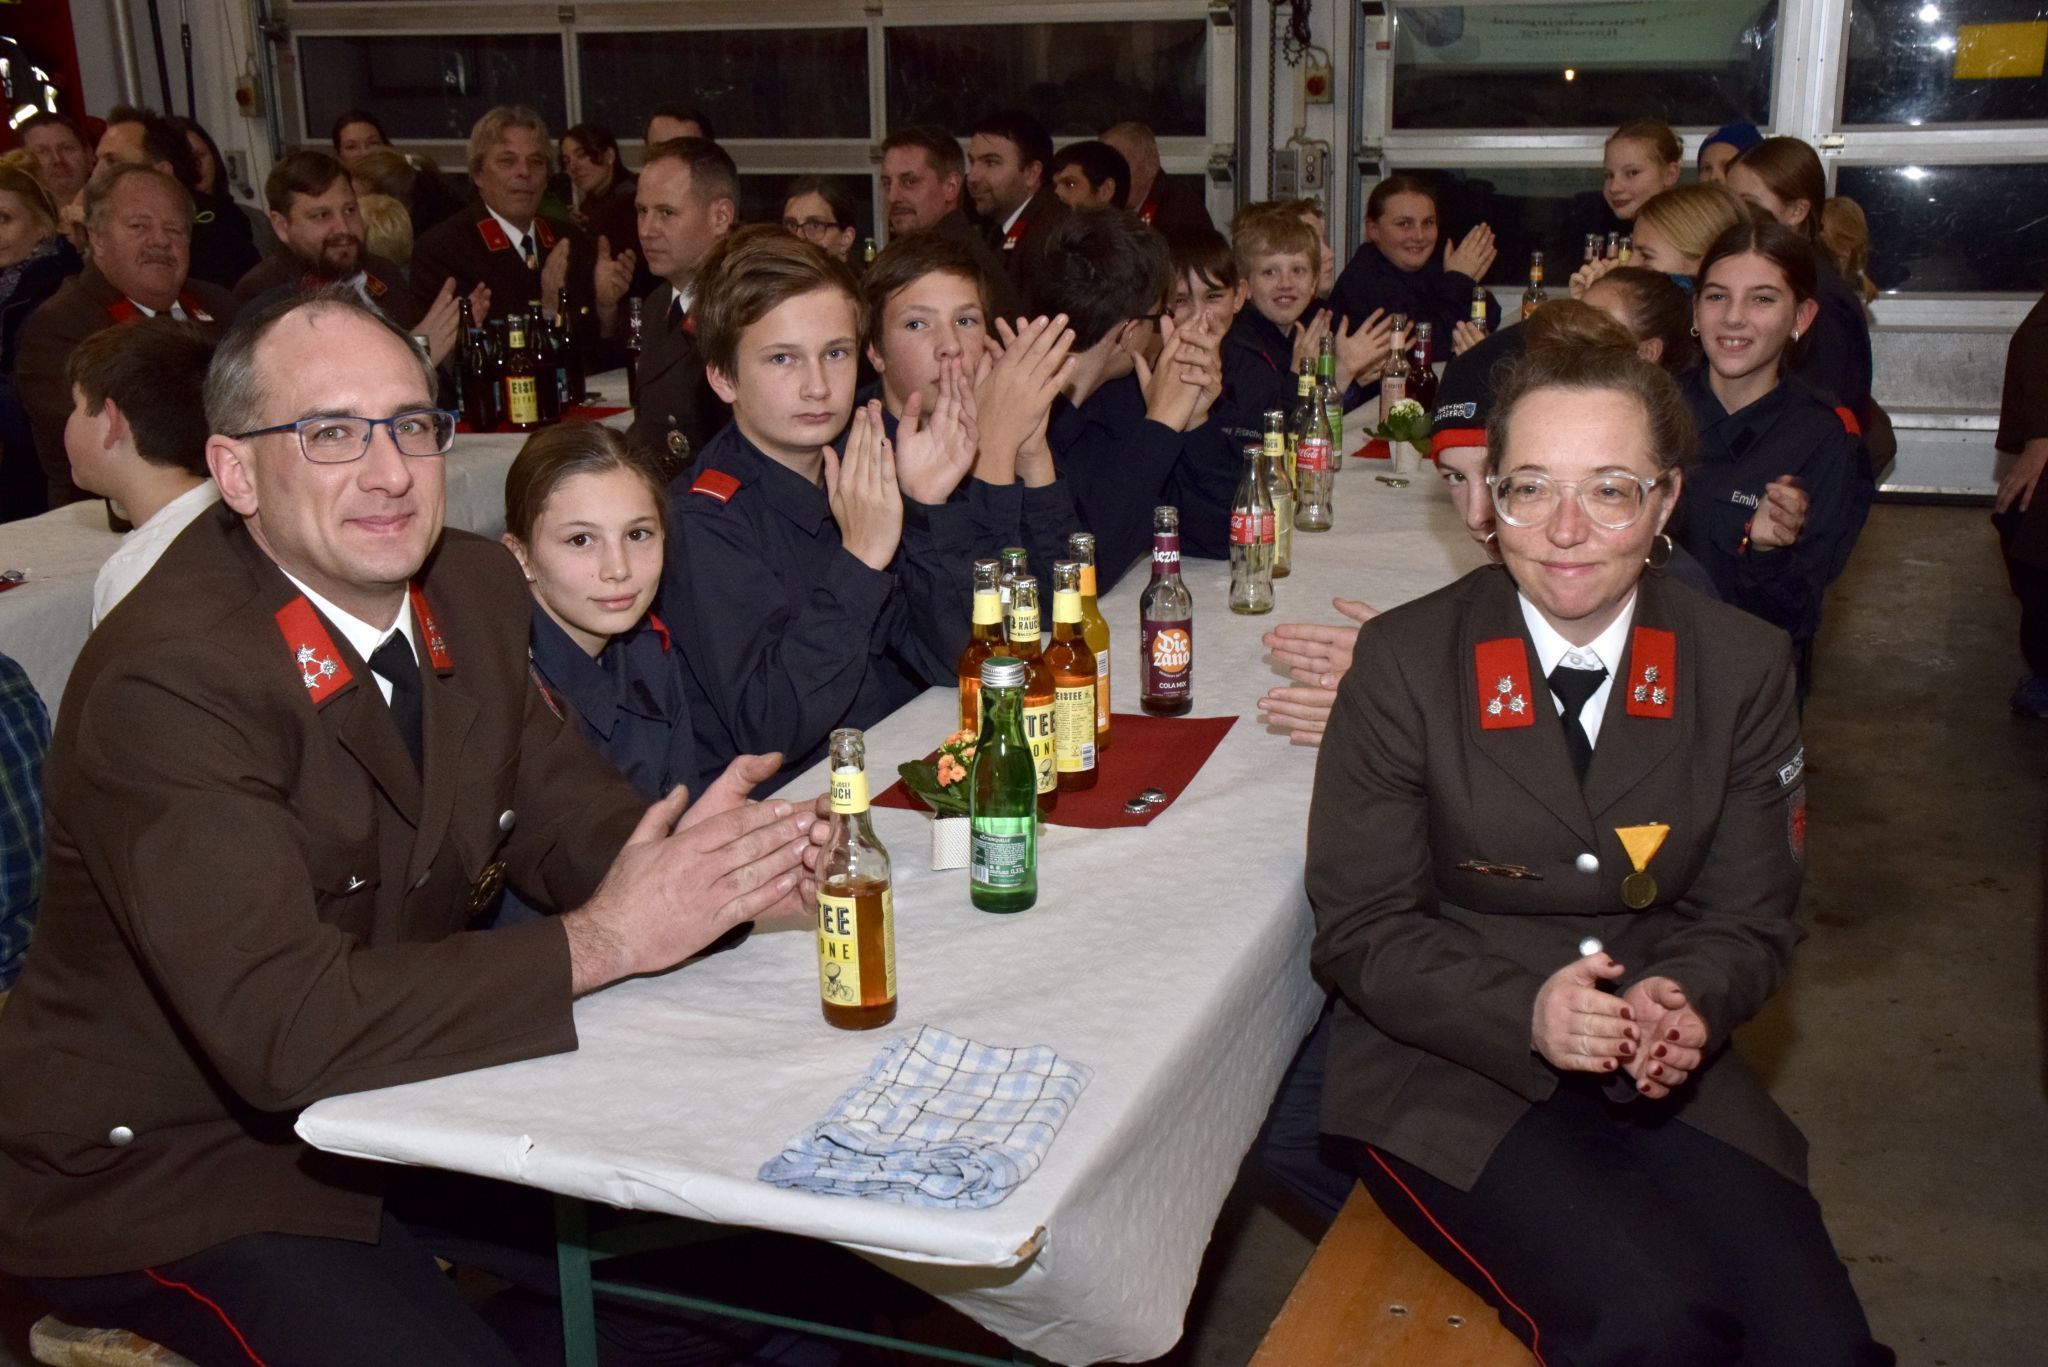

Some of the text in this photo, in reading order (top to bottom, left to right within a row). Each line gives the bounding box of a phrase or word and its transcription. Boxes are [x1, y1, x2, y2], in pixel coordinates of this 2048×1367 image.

[511, 381, 536, 394] EIST
[1731, 490, 1760, 510] Emily
[1055, 691, 1083, 701] EISTEE
